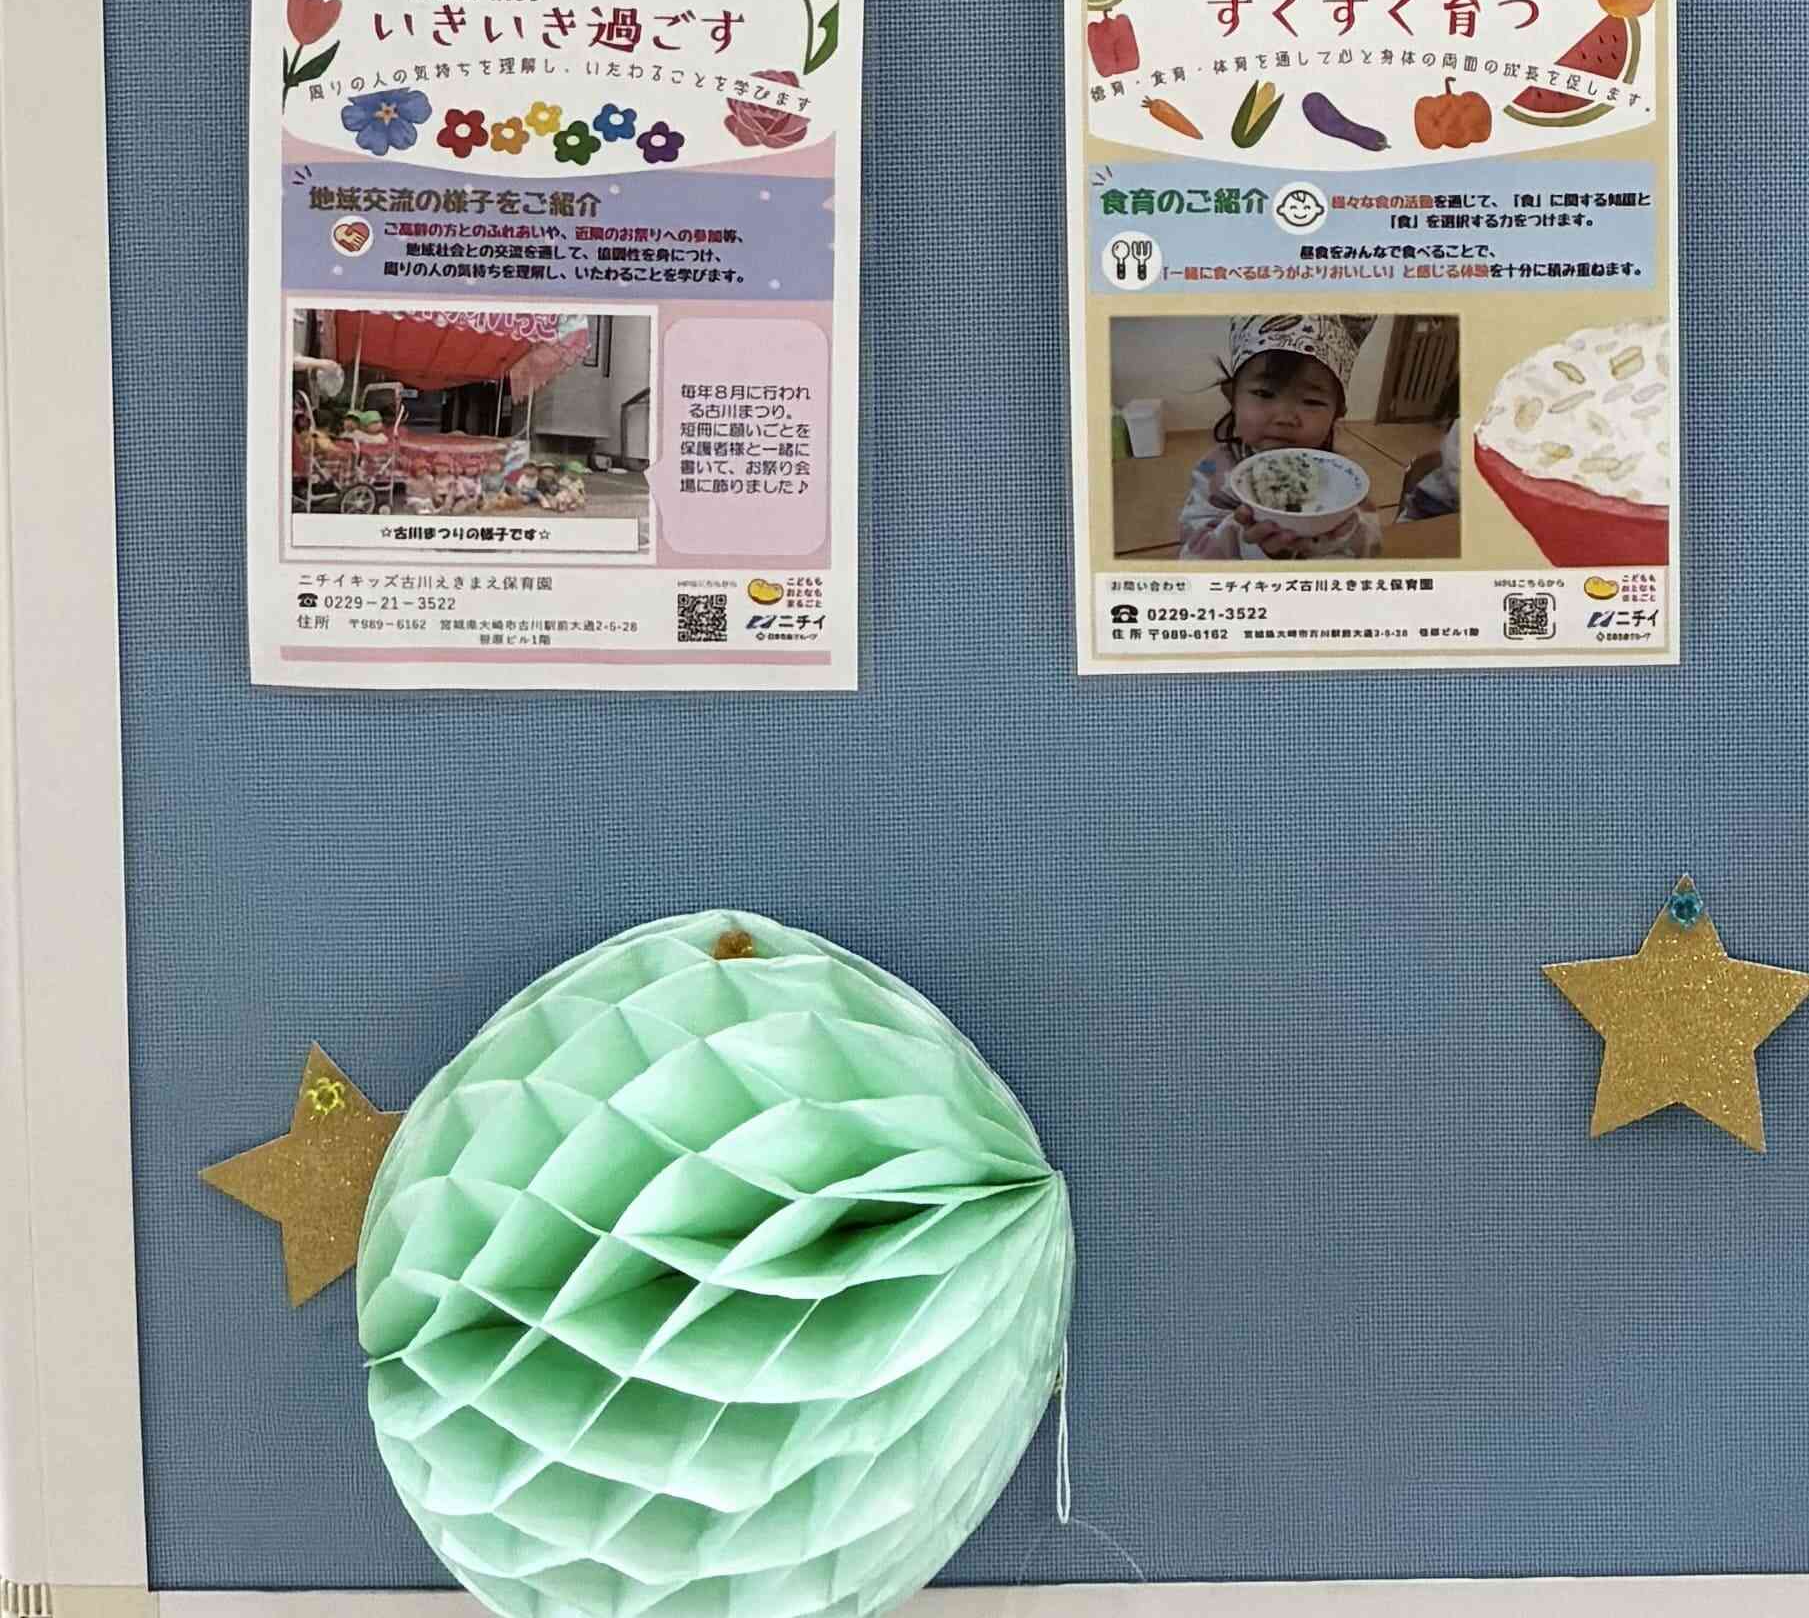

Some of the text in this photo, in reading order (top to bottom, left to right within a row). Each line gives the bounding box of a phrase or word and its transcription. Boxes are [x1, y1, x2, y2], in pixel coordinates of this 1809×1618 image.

[374, 3, 745, 55] いきいき過ごす
[308, 185, 602, 218] 地域交流の様子をご紹介
[1099, 187, 1270, 216] 食育のご紹介
[688, 403, 792, 423] る古川まつり。
[298, 573, 553, 591] ニチイキッズ古川えきまえ保育園
[1147, 606, 1268, 622] 0229-21-3522
